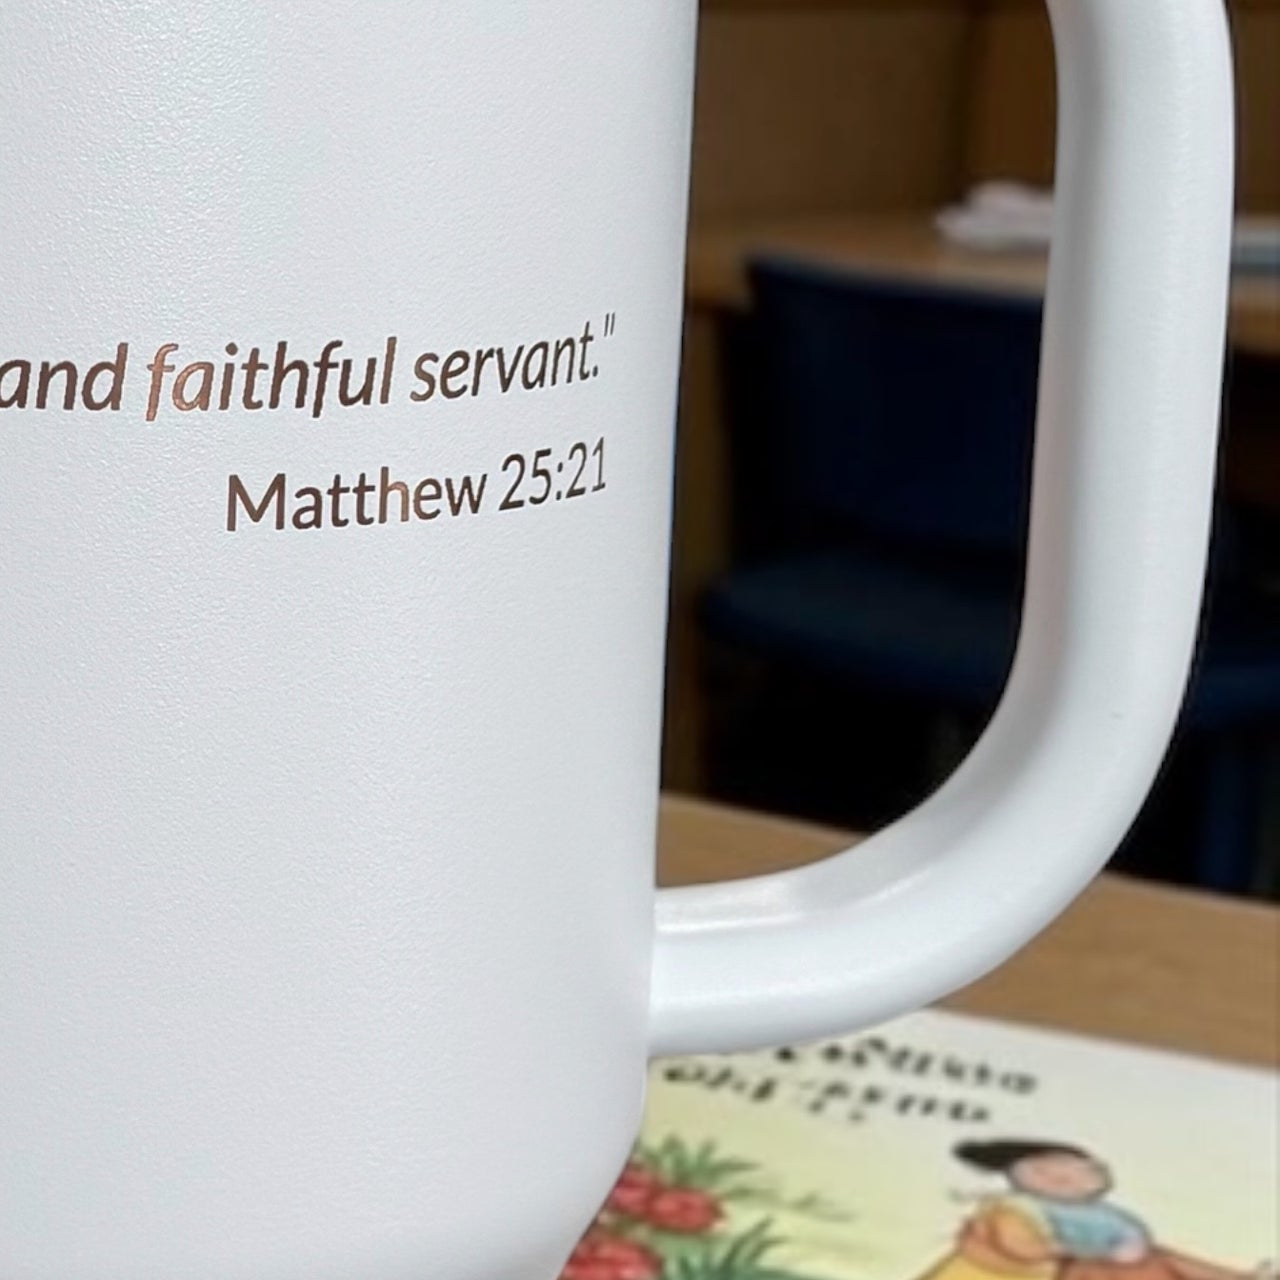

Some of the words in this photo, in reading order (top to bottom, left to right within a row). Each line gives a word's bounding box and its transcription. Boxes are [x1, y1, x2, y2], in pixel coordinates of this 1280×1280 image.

[145, 335, 398, 422] faithful
[409, 311, 616, 403] servant."
[226, 465, 489, 533] Matthew
[497, 436, 607, 512] 25:21
